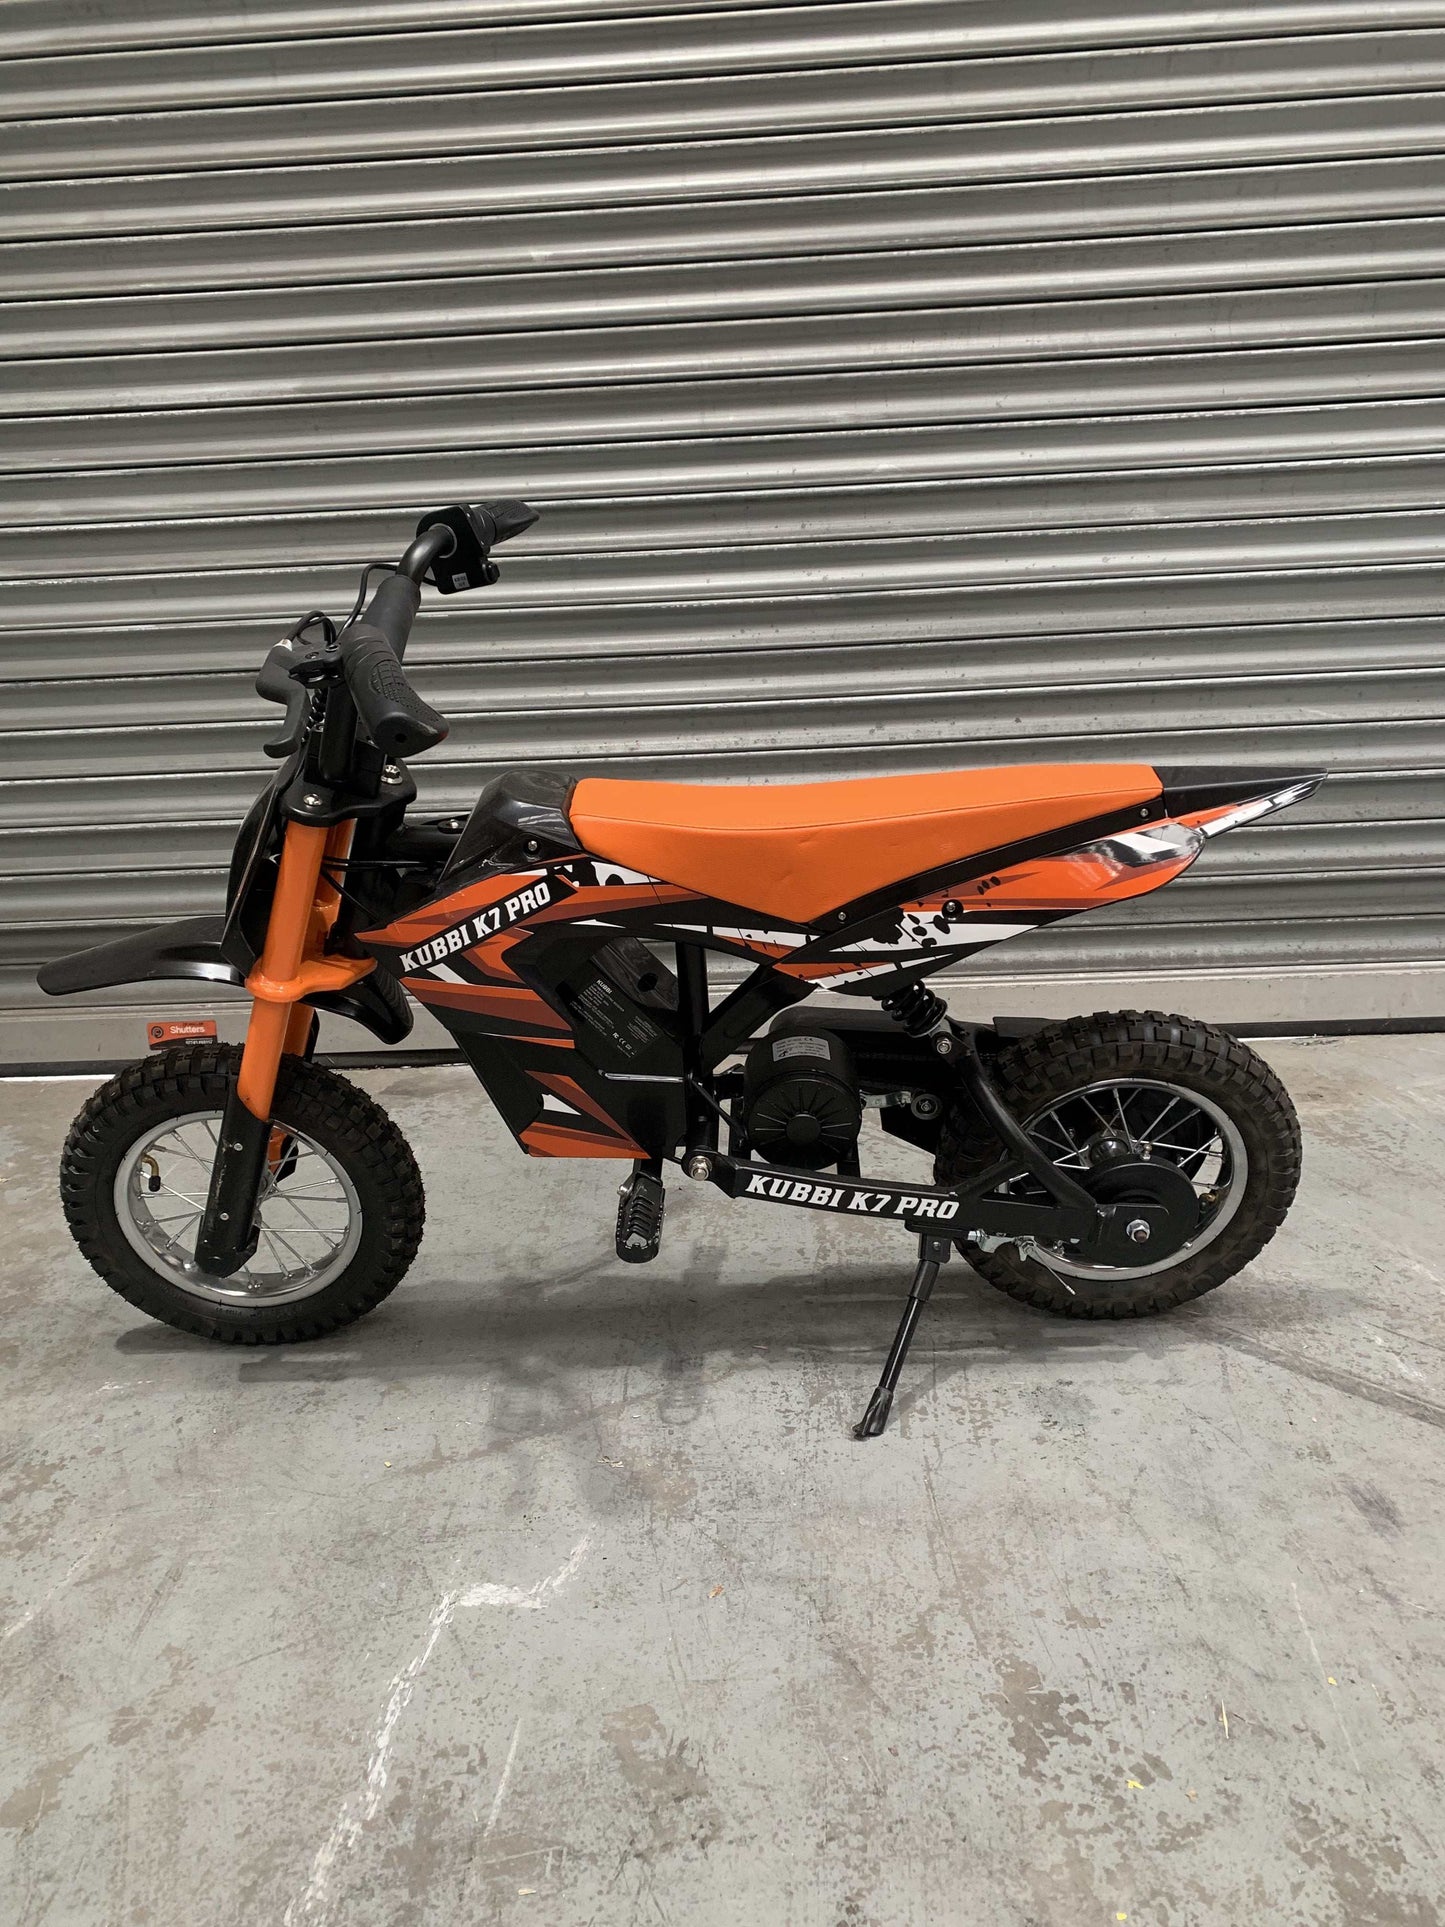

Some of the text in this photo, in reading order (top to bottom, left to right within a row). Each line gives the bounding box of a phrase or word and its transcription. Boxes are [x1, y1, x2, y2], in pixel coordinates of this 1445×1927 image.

[399, 881, 551, 972] KUBBI K7 PRO
[170, 1026, 205, 1034] Shutters
[745, 1173, 960, 1220] KUBBI K7 PRO
